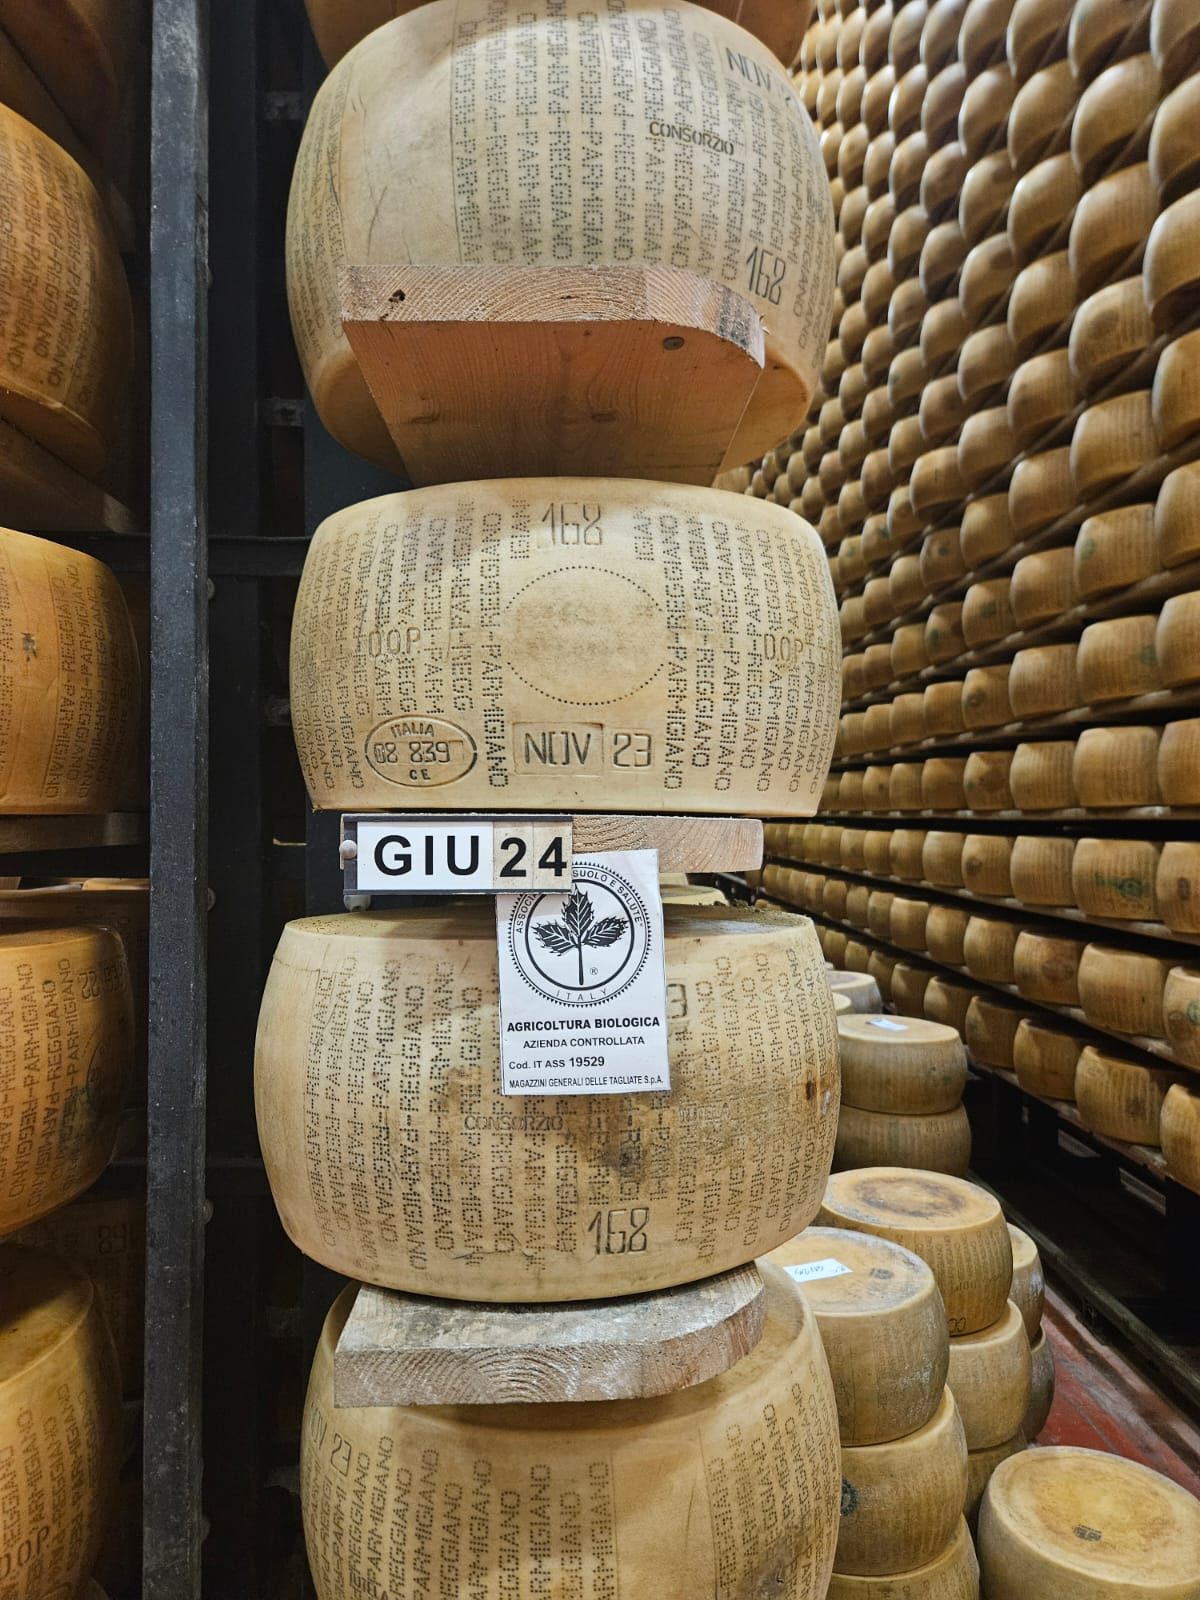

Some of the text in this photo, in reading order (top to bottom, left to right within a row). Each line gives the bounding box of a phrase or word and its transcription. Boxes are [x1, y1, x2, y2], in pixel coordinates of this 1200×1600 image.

[649, 118, 736, 156] CONSORZIO
[745, 245, 787, 306] 168
[542, 501, 603, 546] 168
[480, 512, 509, 788] REGGIANO PARMIGIANO
[659, 515, 689, 790] REGGIANO PARMIGIANO
[711, 520, 741, 792] REGGIANO PARMIGIANO
[390, 722, 435, 738] ITALIA
[691, 647, 715, 769] REGGIANO
[739, 651, 764, 770] REGGIANO
[787, 660, 817, 793] PARMIGIANO
[409, 741, 450, 763] 839
[524, 731, 653, 768] NOV 23
[373, 834, 479, 876] GIU
[572, 869, 642, 923] SUOLO E SALUTE
[556, 988, 607, 1001] ITALY
[348, 981, 374, 1105] REGGIANO
[507, 1016, 661, 1032] AGRICOLTURA BIOLOGICA
[523, 1036, 645, 1049] AZIENDA CONTROLLATA
[508, 1056, 606, 1070] Cod. IT ASS 19529
[509, 1078, 547, 1088] MAGAZZINI
[549, 1076, 583, 1087] GENERALI
[585, 1076, 608, 1086] DELLE
[609, 1075, 643, 1085] TAGLIATE
[373, 960, 401, 1242] PARMIGIANO REGGIANO
[399, 985, 428, 1269] REGGIANO PARMIGIANO
[430, 960, 455, 1250] PARMIGIANO REGGIANO
[491, 1132, 514, 1253] REGGIANO
[588, 1207, 650, 1255] 168
[389, 1468, 413, 1598] REGGIANO
